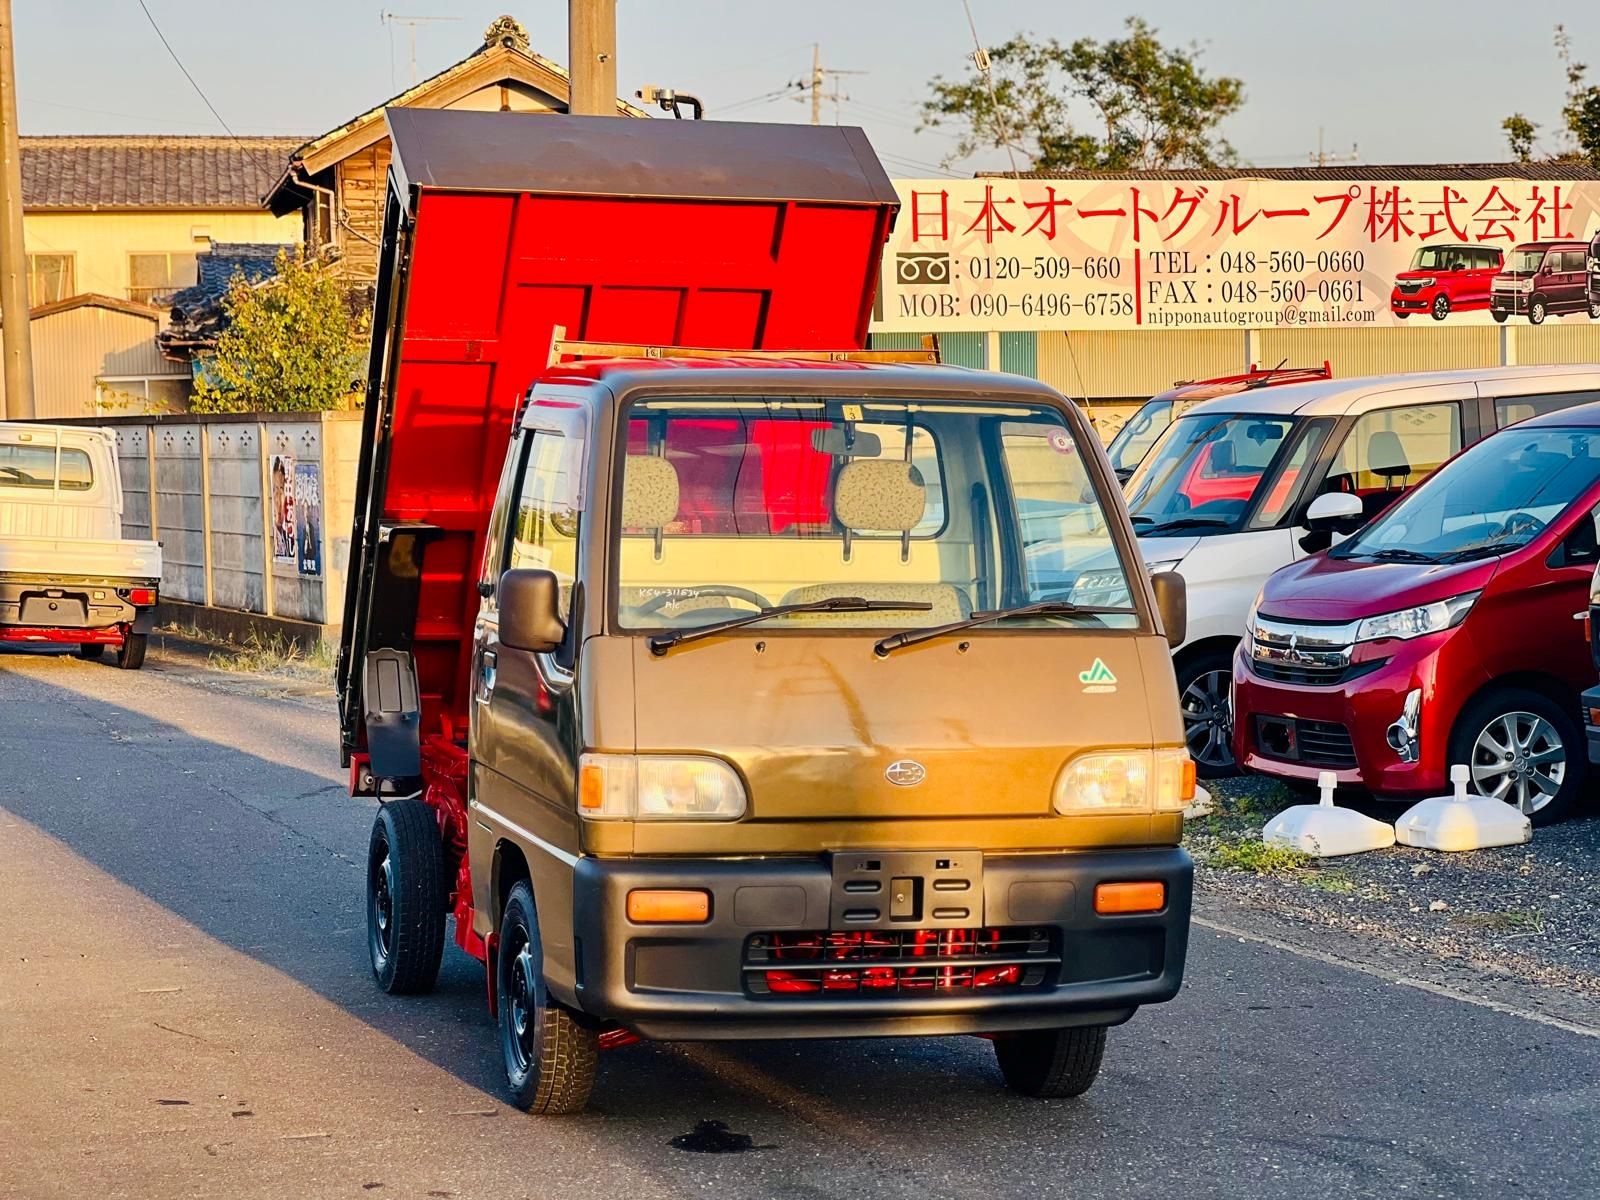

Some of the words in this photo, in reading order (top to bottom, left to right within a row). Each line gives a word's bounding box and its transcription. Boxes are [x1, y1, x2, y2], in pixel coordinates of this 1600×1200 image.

[911, 184, 1574, 244] 日本オートグループ株式会社
[969, 256, 1121, 279] 0120-509-660
[1220, 250, 1365, 273] 048-560-0660
[1221, 280, 1365, 303] 048-560-0661
[970, 293, 1134, 317] 090-6496-6758
[1147, 305, 1376, 326] nipponautogroup@gmail.com
